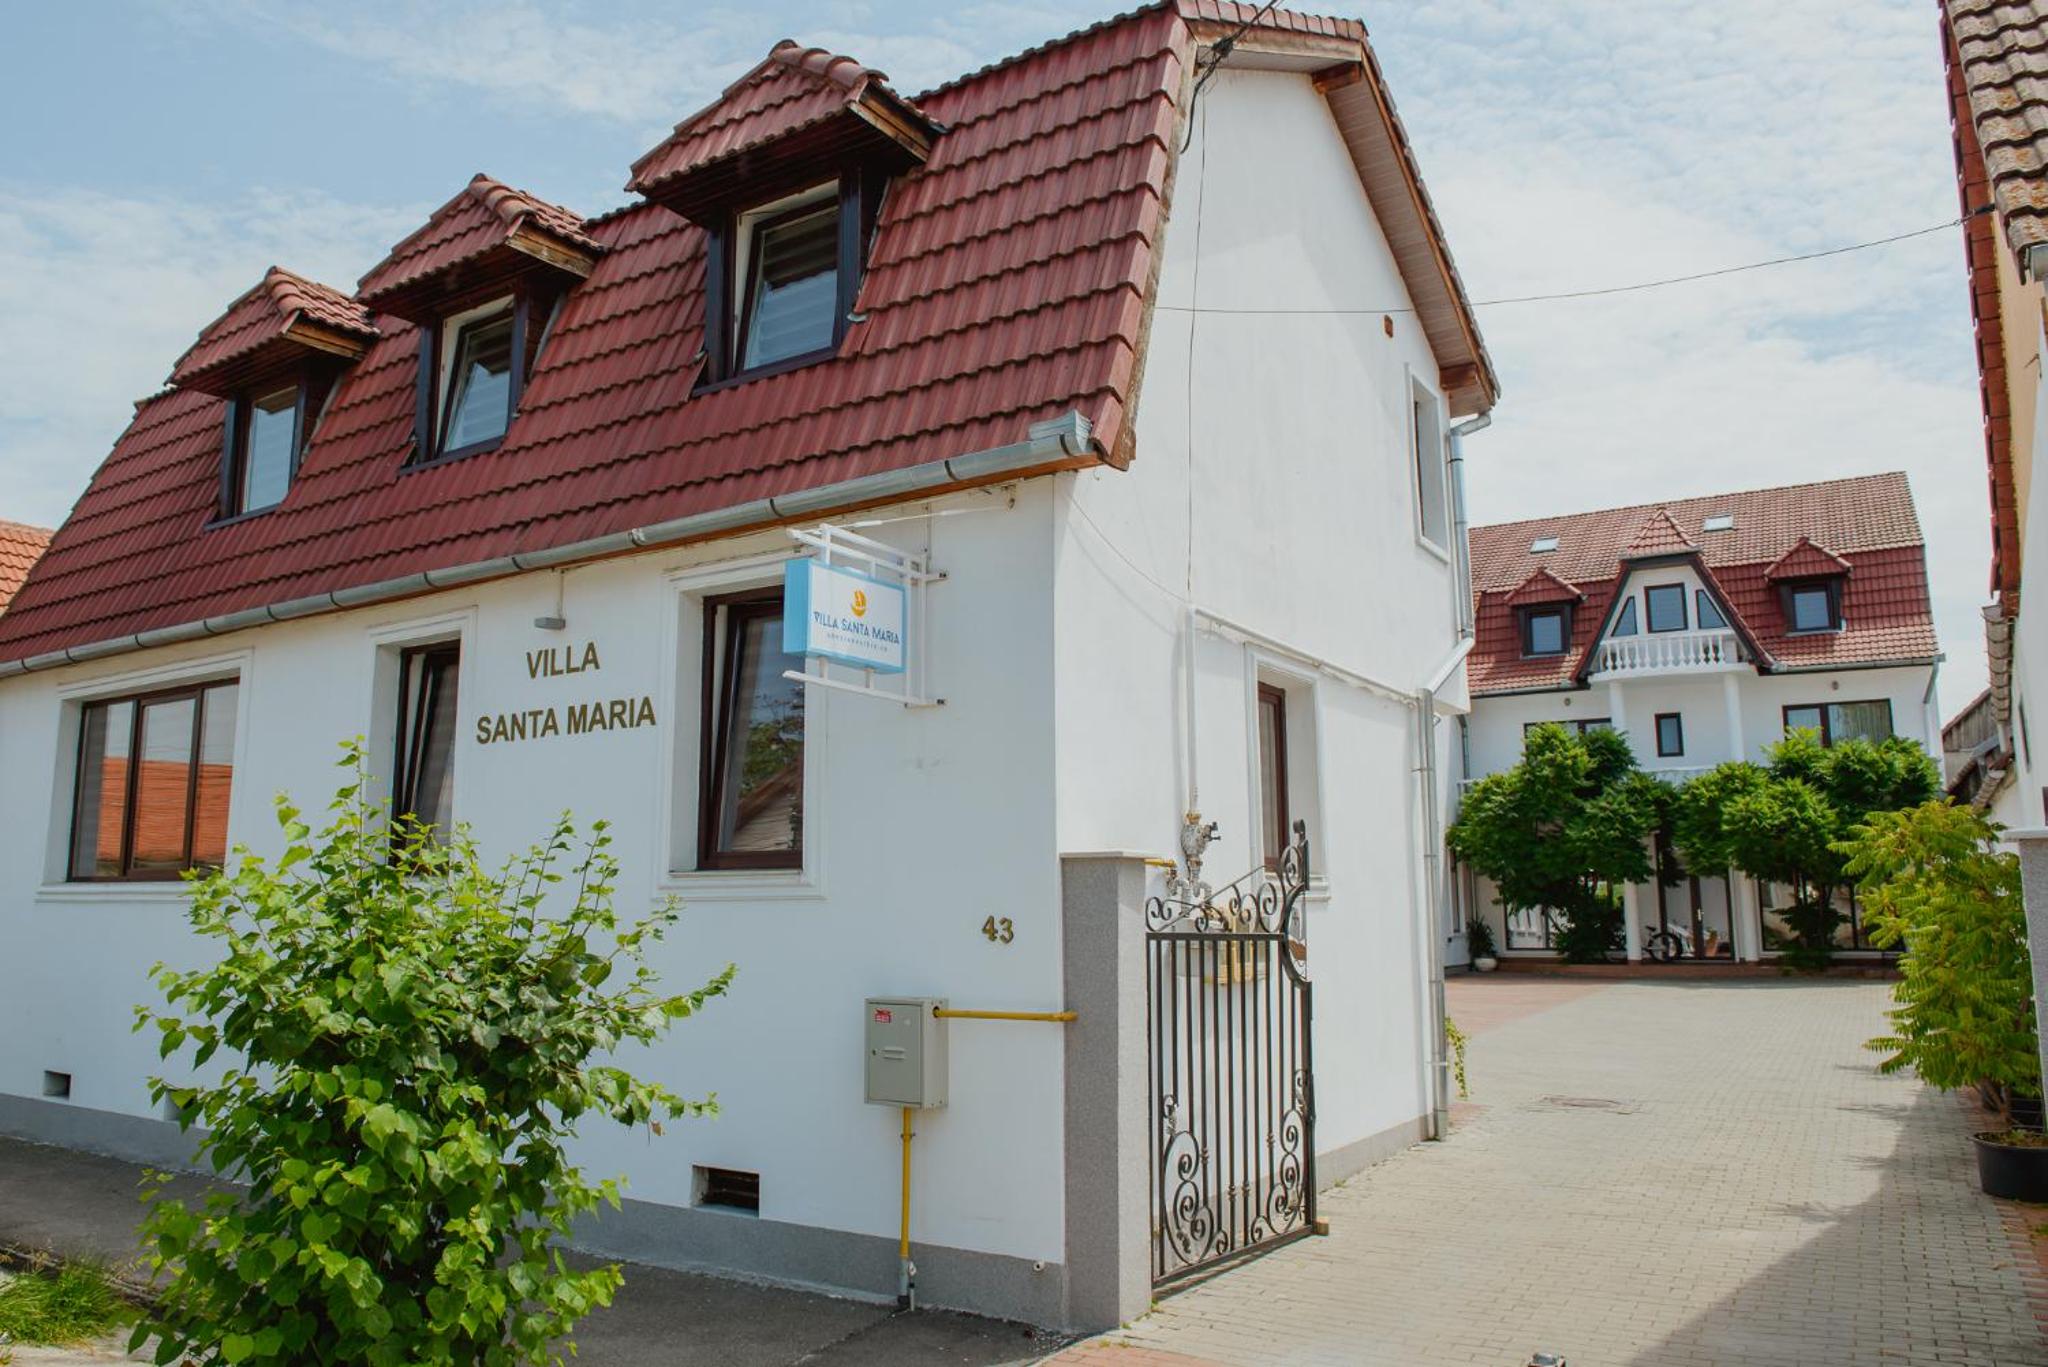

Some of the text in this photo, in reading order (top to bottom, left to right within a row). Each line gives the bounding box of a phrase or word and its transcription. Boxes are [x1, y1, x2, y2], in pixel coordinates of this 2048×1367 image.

[813, 611, 839, 629] VILLA
[841, 618, 869, 636] SANTA
[872, 626, 900, 644] MARIA
[526, 642, 600, 679] VILLA
[476, 696, 656, 744] SANTA MARIA
[981, 915, 1014, 944] 43
